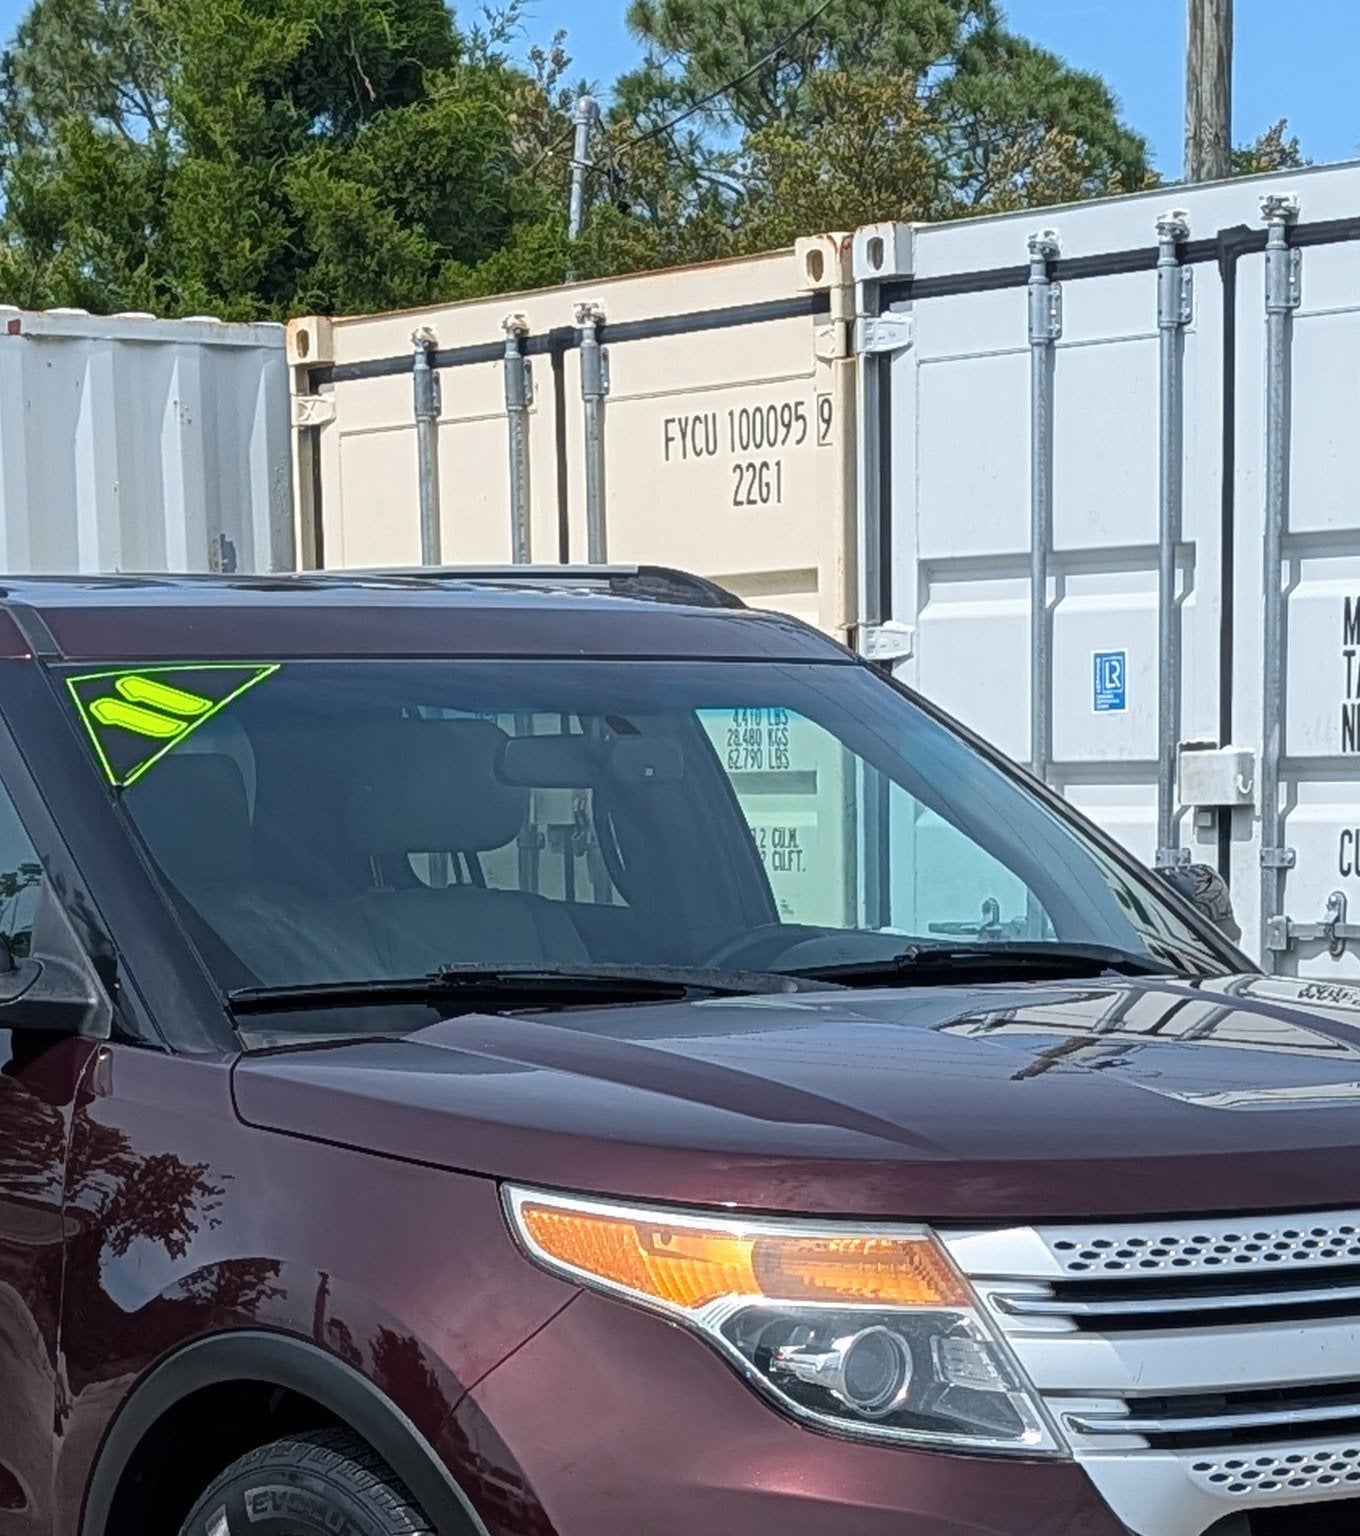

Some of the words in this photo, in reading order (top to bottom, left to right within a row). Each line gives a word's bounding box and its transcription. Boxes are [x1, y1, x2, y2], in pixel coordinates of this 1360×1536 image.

[664, 412, 717, 461] FYCU
[728, 400, 807, 454] 100095
[819, 398, 833, 440] 9
[733, 460, 781, 506] 22G1
